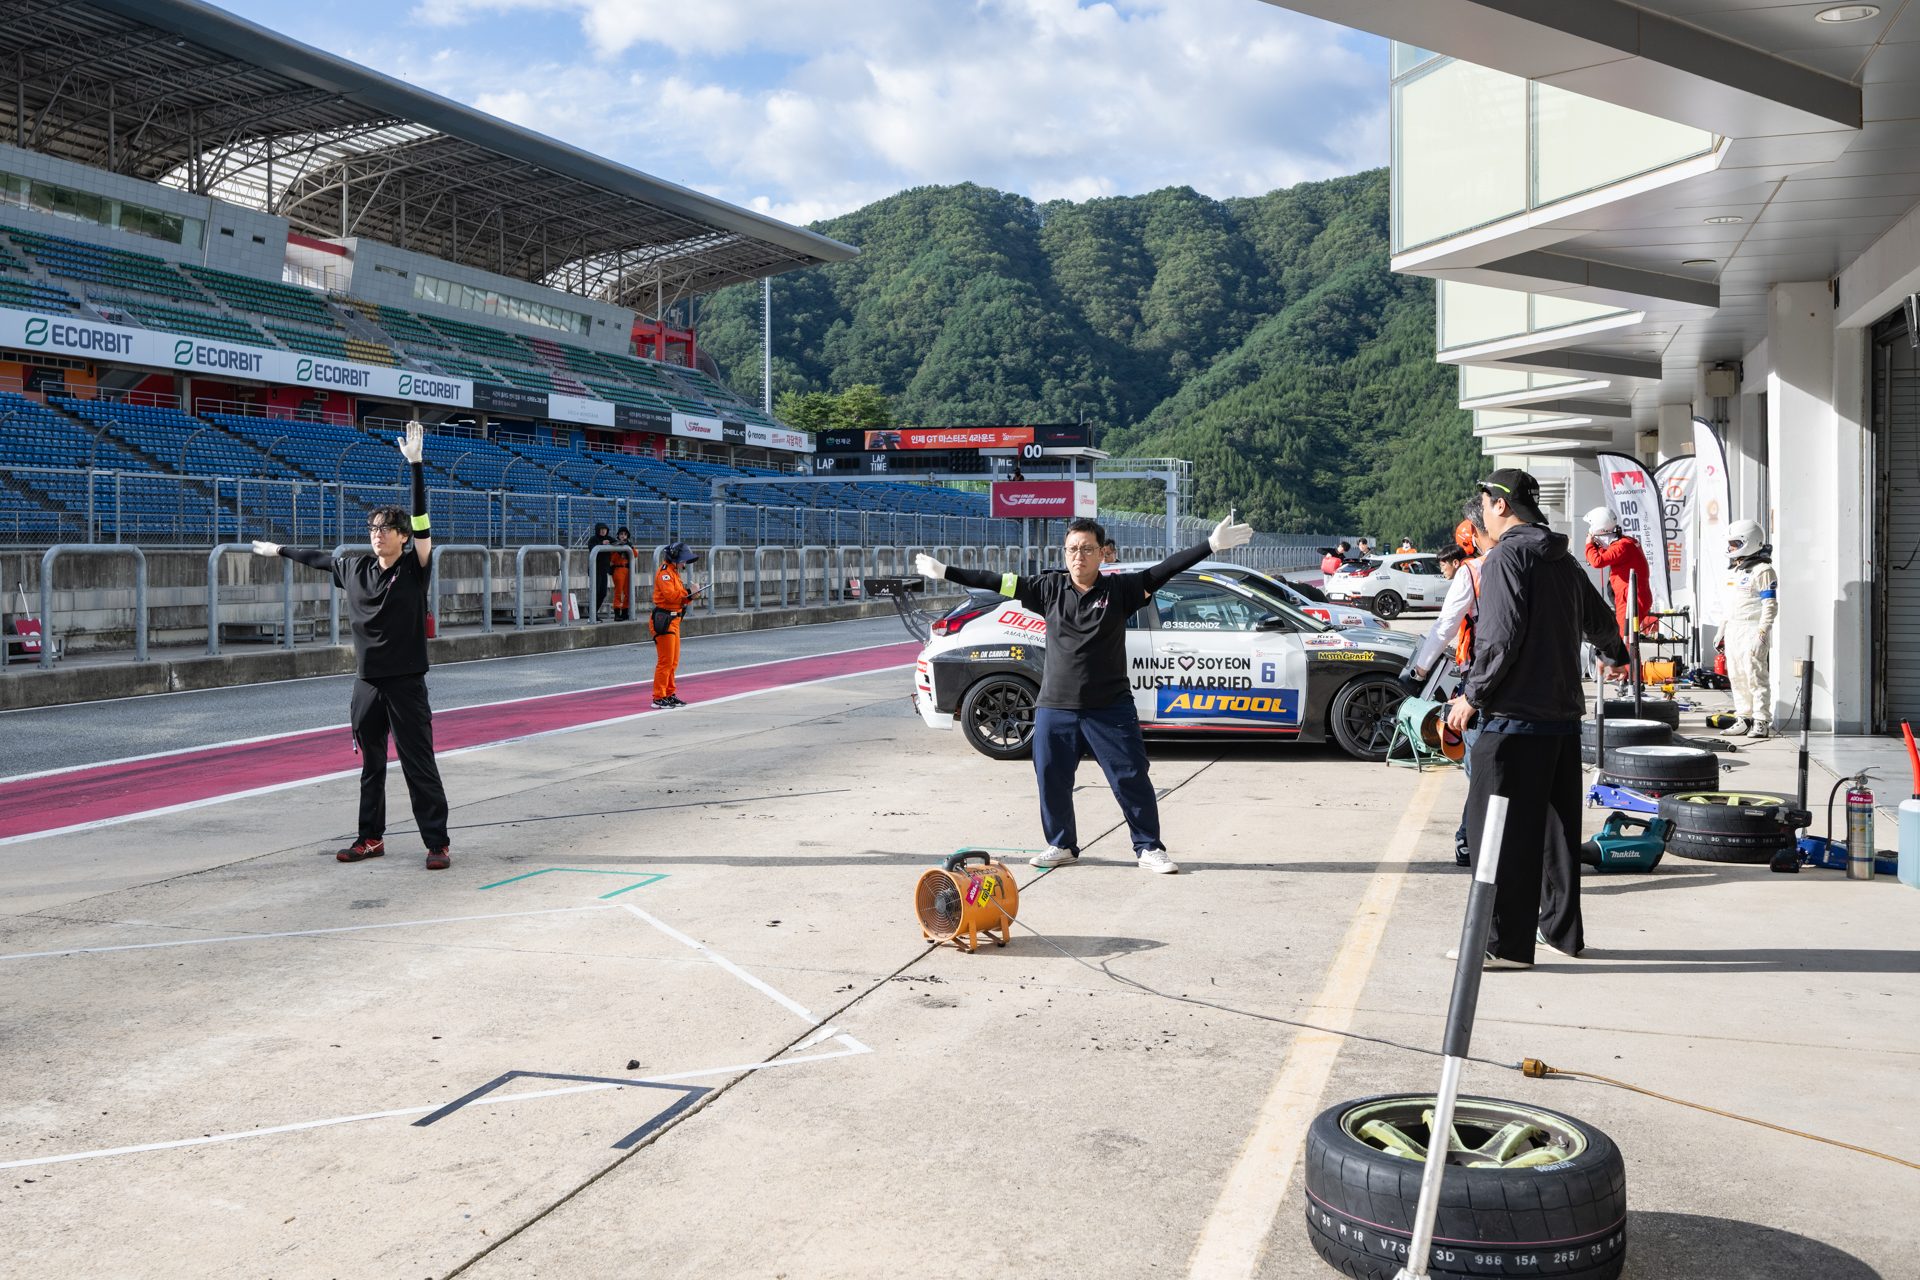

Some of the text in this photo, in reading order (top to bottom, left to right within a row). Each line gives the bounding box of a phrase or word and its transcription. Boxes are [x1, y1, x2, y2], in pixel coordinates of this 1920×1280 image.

[52, 324, 133, 355] ECORBIT
[196, 346, 262, 372] ECORBIT
[314, 364, 370, 387] ECORBIT
[414, 379, 461, 400] ECORBIT
[911, 435, 925, 444] 인제
[926, 435, 937, 443] GT
[938, 434, 967, 443] 마스터즈
[969, 433, 996, 442] 4라운드
[872, 454, 885, 462] LAP
[1023, 444, 1042, 459] 00
[817, 458, 834, 470] LAP
[870, 463, 887, 471] TIME
[1002, 494, 1066, 506] SPEEDIUM
[1664, 477, 1688, 540] LeTech
[1132, 657, 1251, 670] MINJE SOYEON
[1261, 662, 1276, 683] 6
[1132, 676, 1252, 691] JUST MARRIED
[1164, 693, 1287, 713] AUTOOL
[1610, 850, 1640, 859] Makita
[1322, 1213, 1331, 1227] 35
[1340, 1223, 1347, 1235] R
[1353, 1231, 1364, 1242] 18
[1436, 1250, 1455, 1262] 3D
[1514, 1255, 1538, 1266] 15A
[1591, 1244, 1601, 1256] 35
